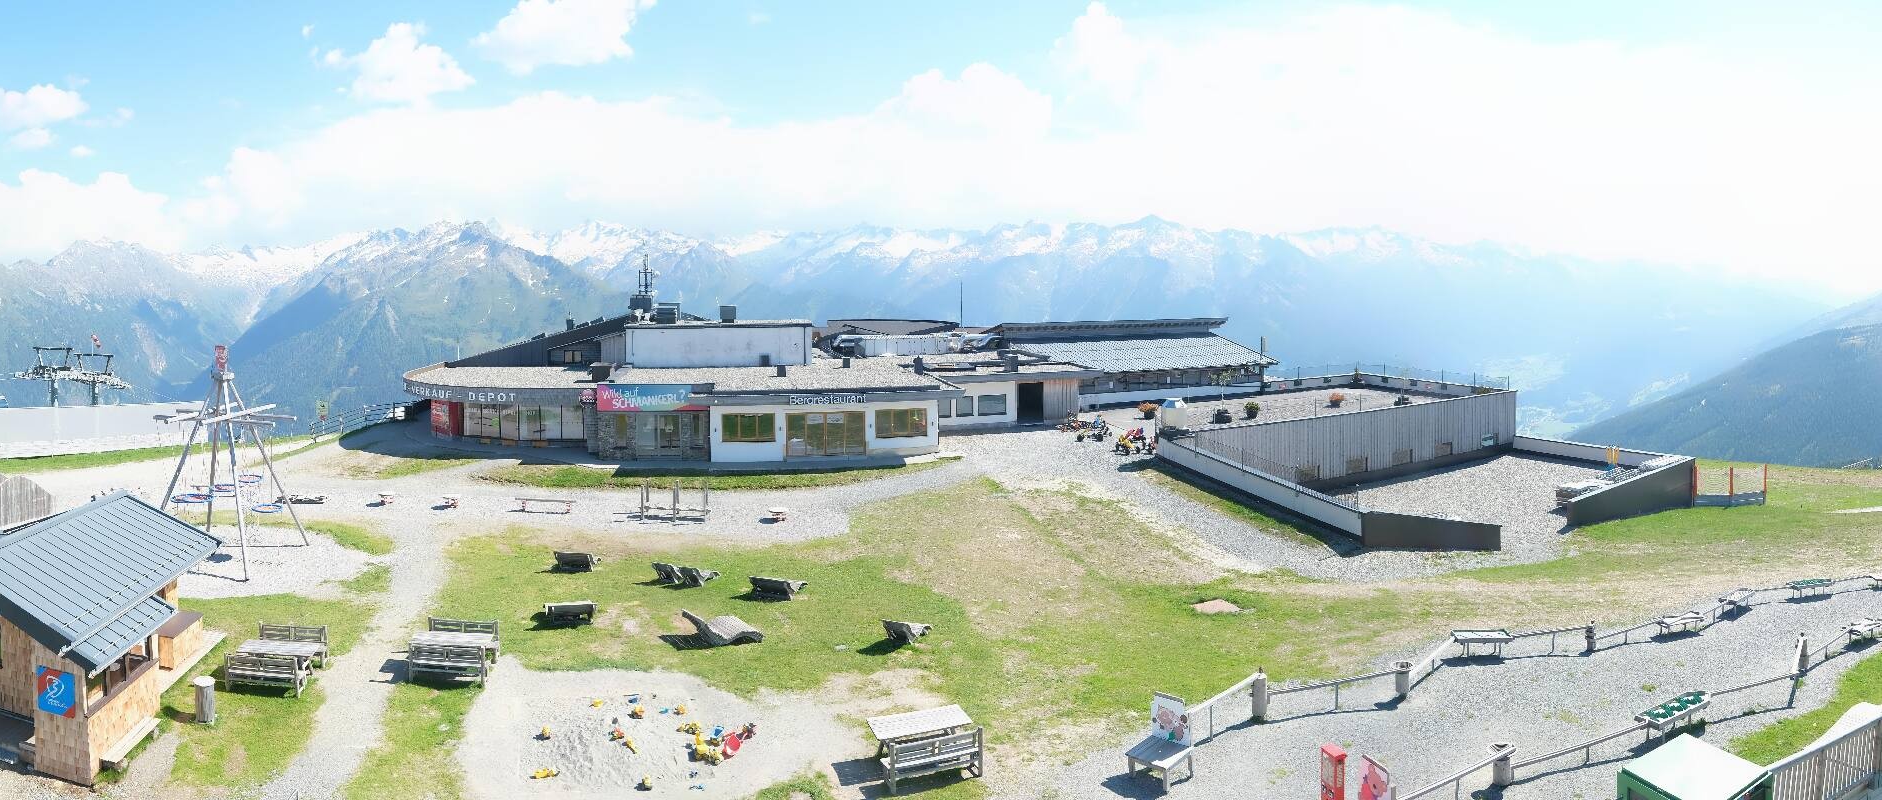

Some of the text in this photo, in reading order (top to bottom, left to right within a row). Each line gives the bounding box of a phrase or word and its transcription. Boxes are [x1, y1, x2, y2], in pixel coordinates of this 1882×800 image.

[468, 391, 516, 402] DEPOT
[601, 388, 622, 399] Wild
[625, 386, 639, 398] auf
[612, 389, 685, 409] SCHMANKERL?
[789, 394, 867, 405] Bergrestaurant
